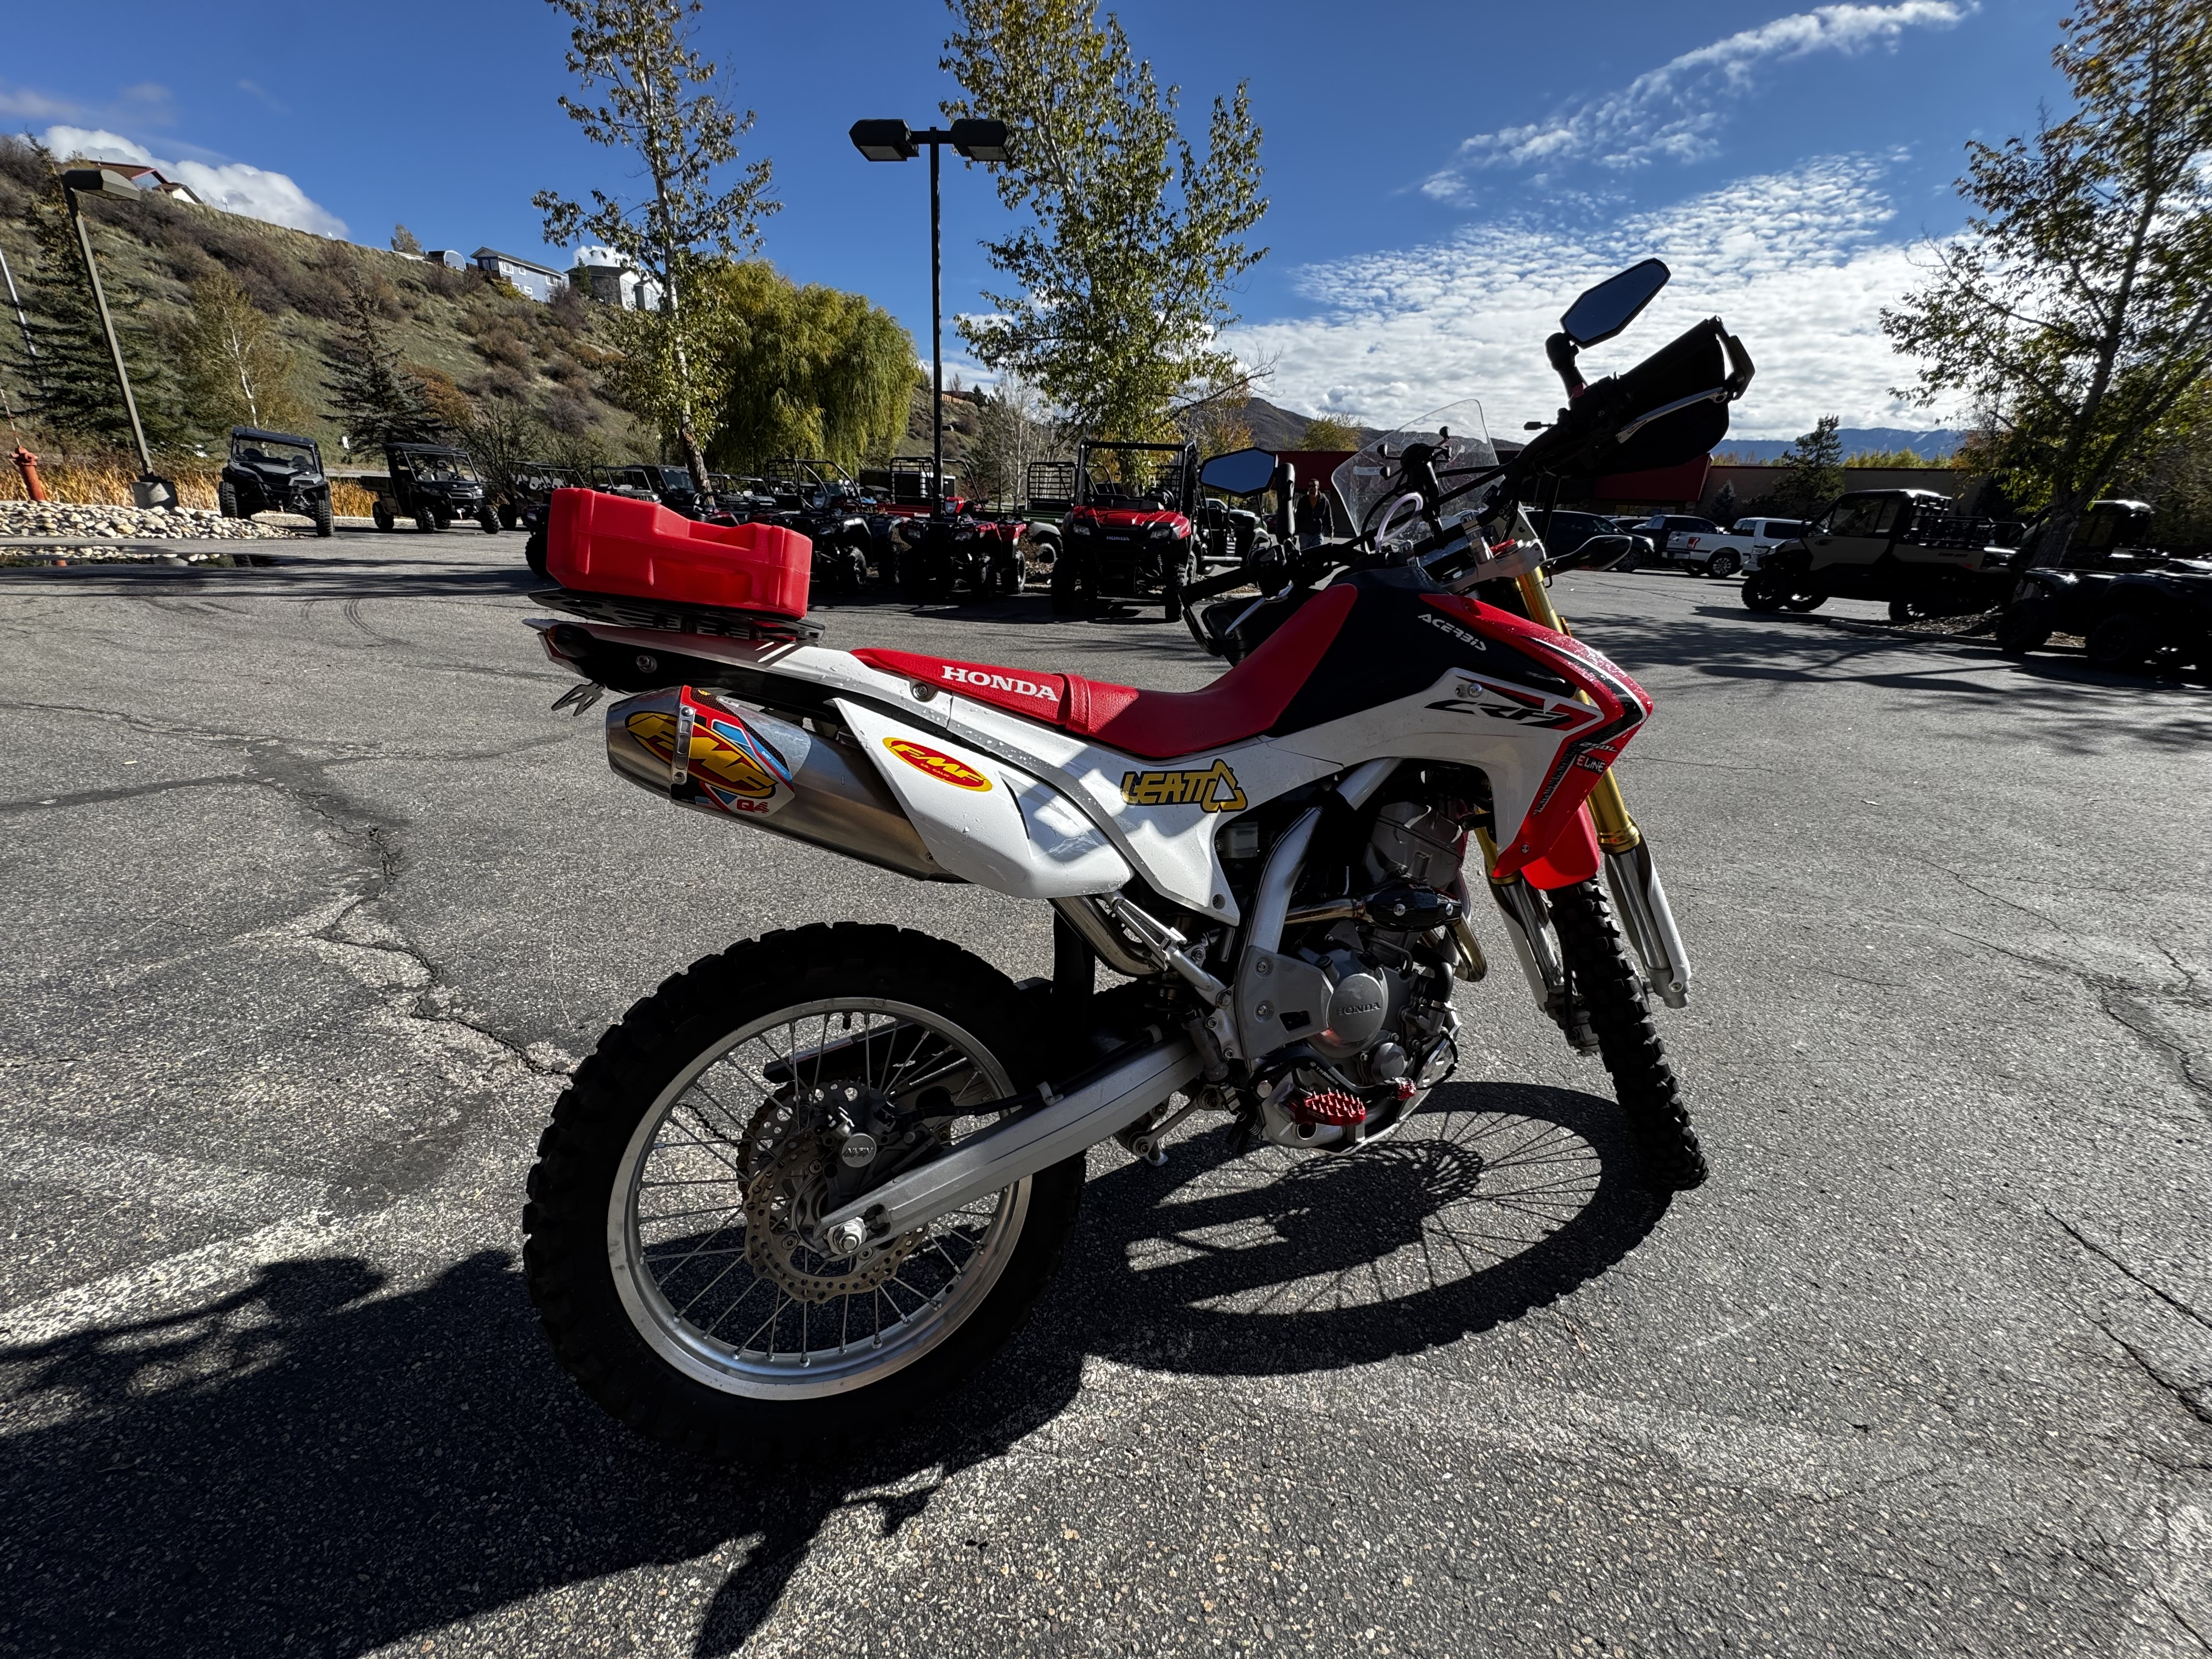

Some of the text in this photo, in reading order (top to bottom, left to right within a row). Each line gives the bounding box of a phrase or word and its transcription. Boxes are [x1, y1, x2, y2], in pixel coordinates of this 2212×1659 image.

[941, 665, 1059, 702] HONDA
[1424, 699, 1573, 729] CRF
[627, 714, 780, 792] FMF
[1579, 742, 1619, 752] 250L
[890, 743, 986, 783] FMF
[736, 799, 769, 814] Q4
[1338, 1002, 1381, 1016] HONDA
